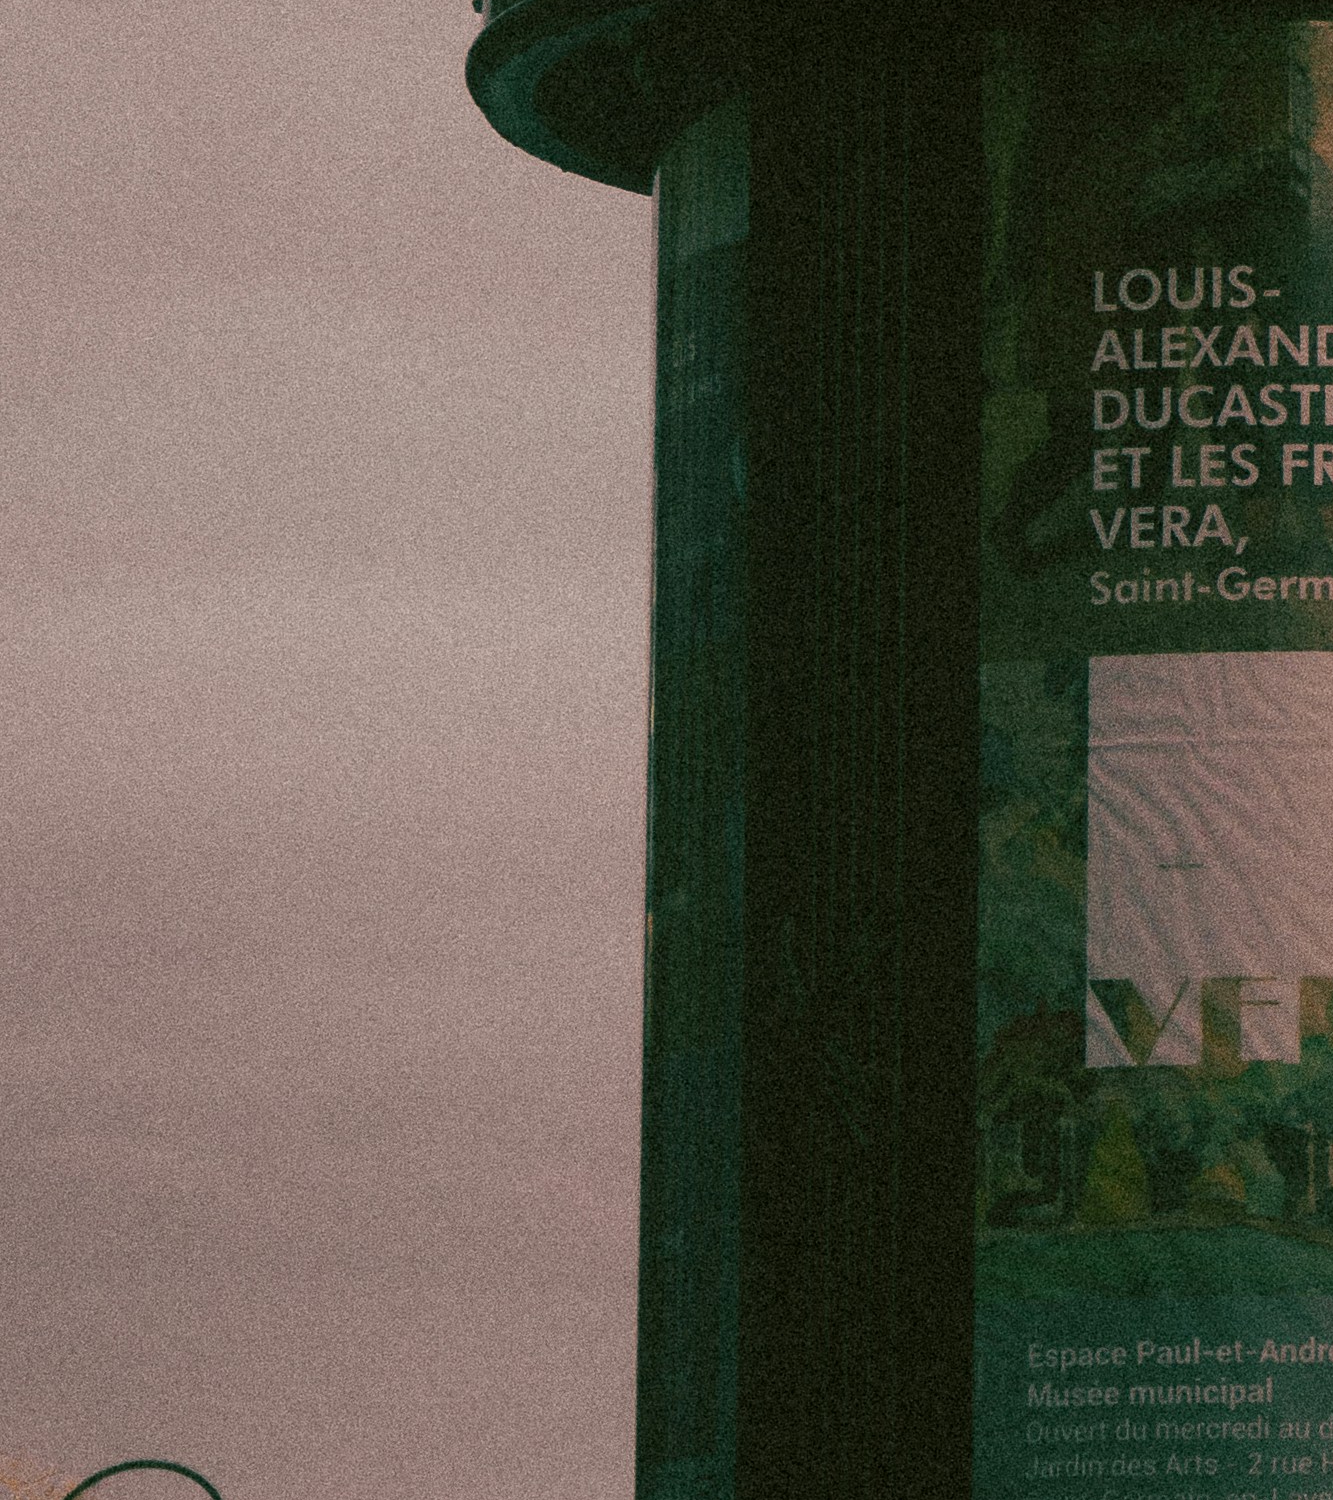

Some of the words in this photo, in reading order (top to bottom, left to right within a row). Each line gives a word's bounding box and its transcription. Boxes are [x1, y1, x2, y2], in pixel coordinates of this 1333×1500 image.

[1093, 265, 1281, 311] LOUIS-
[1092, 447, 1148, 491] ET
[1173, 444, 1258, 488] LES
[1091, 506, 1249, 554] VERA,
[1027, 1341, 1129, 1372] Espace
[1027, 1380, 1121, 1408] Musée
[1128, 1376, 1274, 1410] municipal
[1026, 1419, 1108, 1445] Ouvert
[1115, 1418, 1148, 1442] du
[1155, 1416, 1271, 1442] mercredi
[1278, 1419, 1312, 1441] au
[1025, 1455, 1105, 1481] Jardin
[1111, 1455, 1157, 1477] des
[1166, 1452, 1219, 1477] Arts
[1247, 1452, 1263, 1477] 2
[1271, 1457, 1313, 1475] rue
